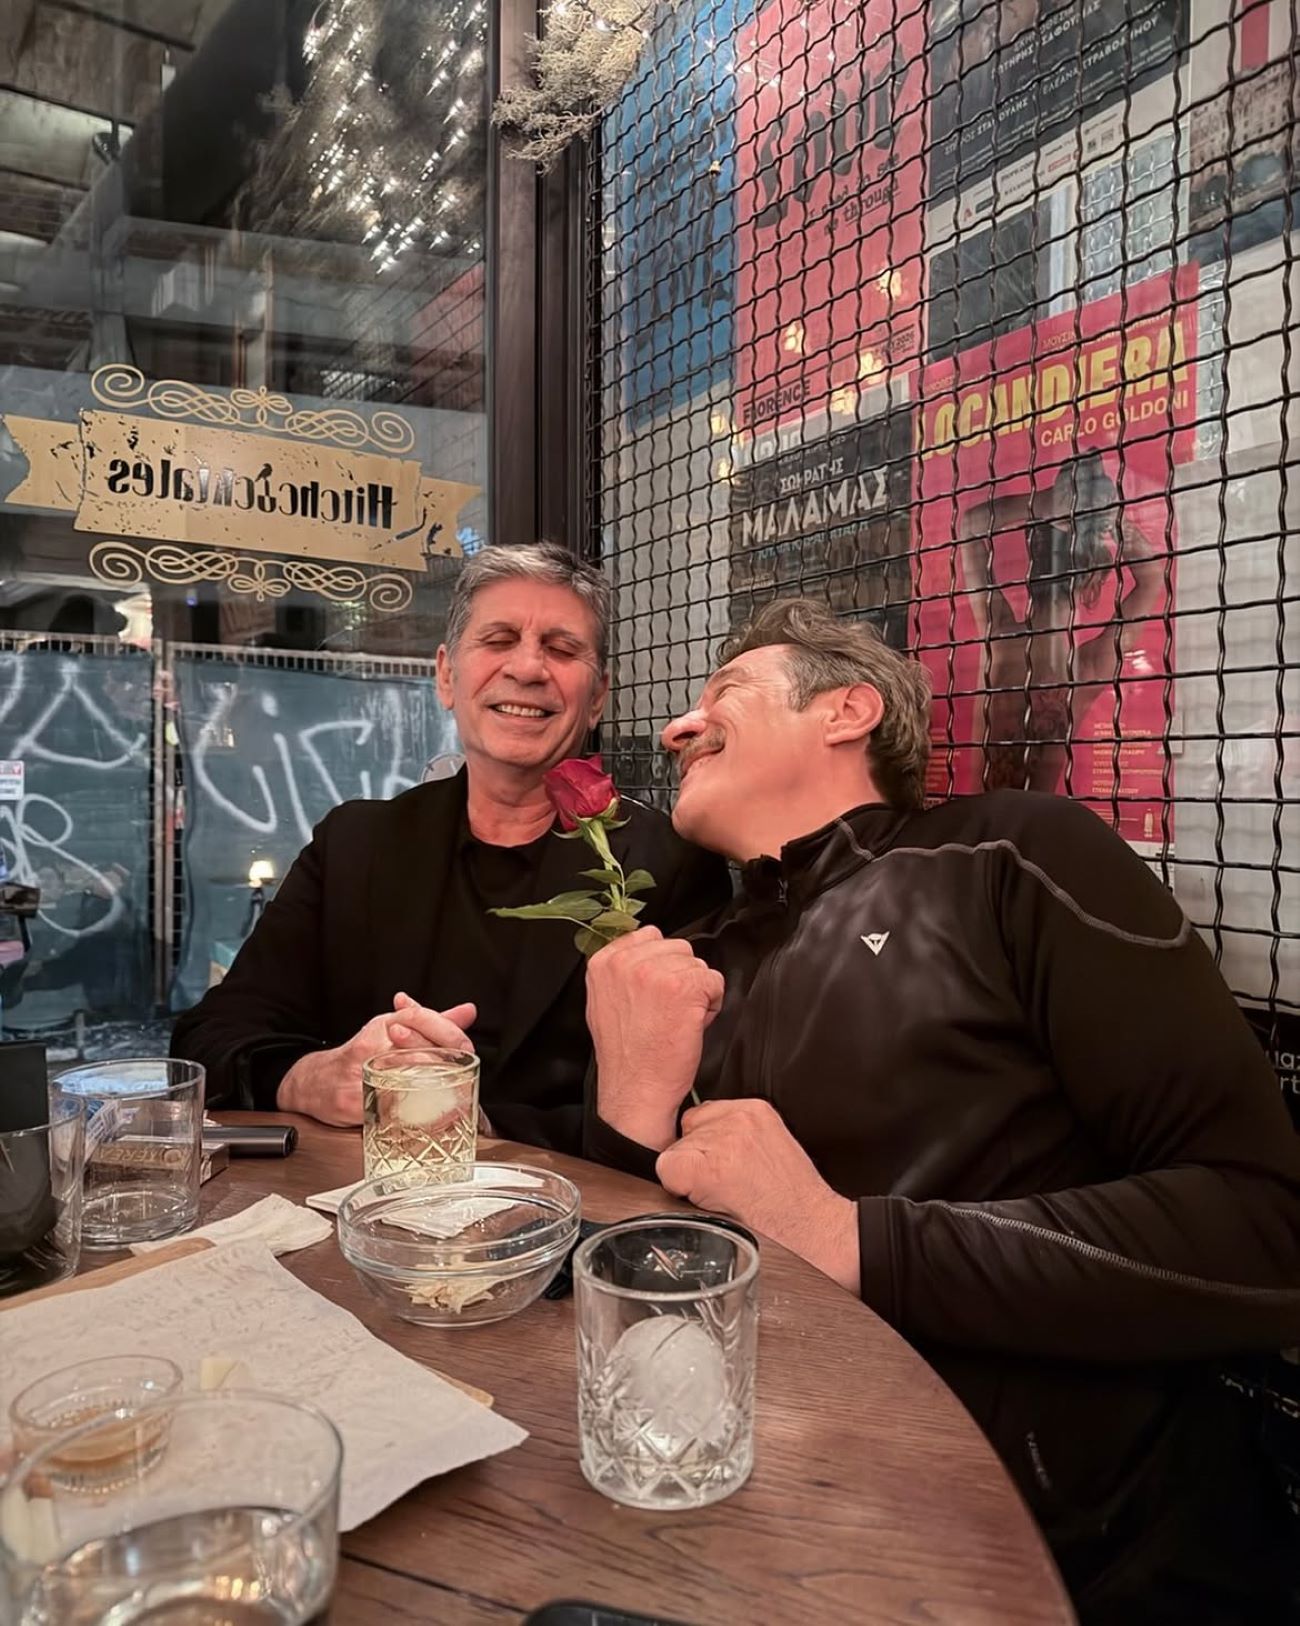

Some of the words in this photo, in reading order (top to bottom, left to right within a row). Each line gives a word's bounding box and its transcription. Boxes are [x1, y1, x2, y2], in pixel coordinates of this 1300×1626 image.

[915, 321, 1188, 462] LOCANDIERA
[1041, 416, 1097, 448] CARLO
[1102, 390, 1188, 430] GOLDONI
[742, 465, 888, 547] ΜΑΛΑΜΑΣ
